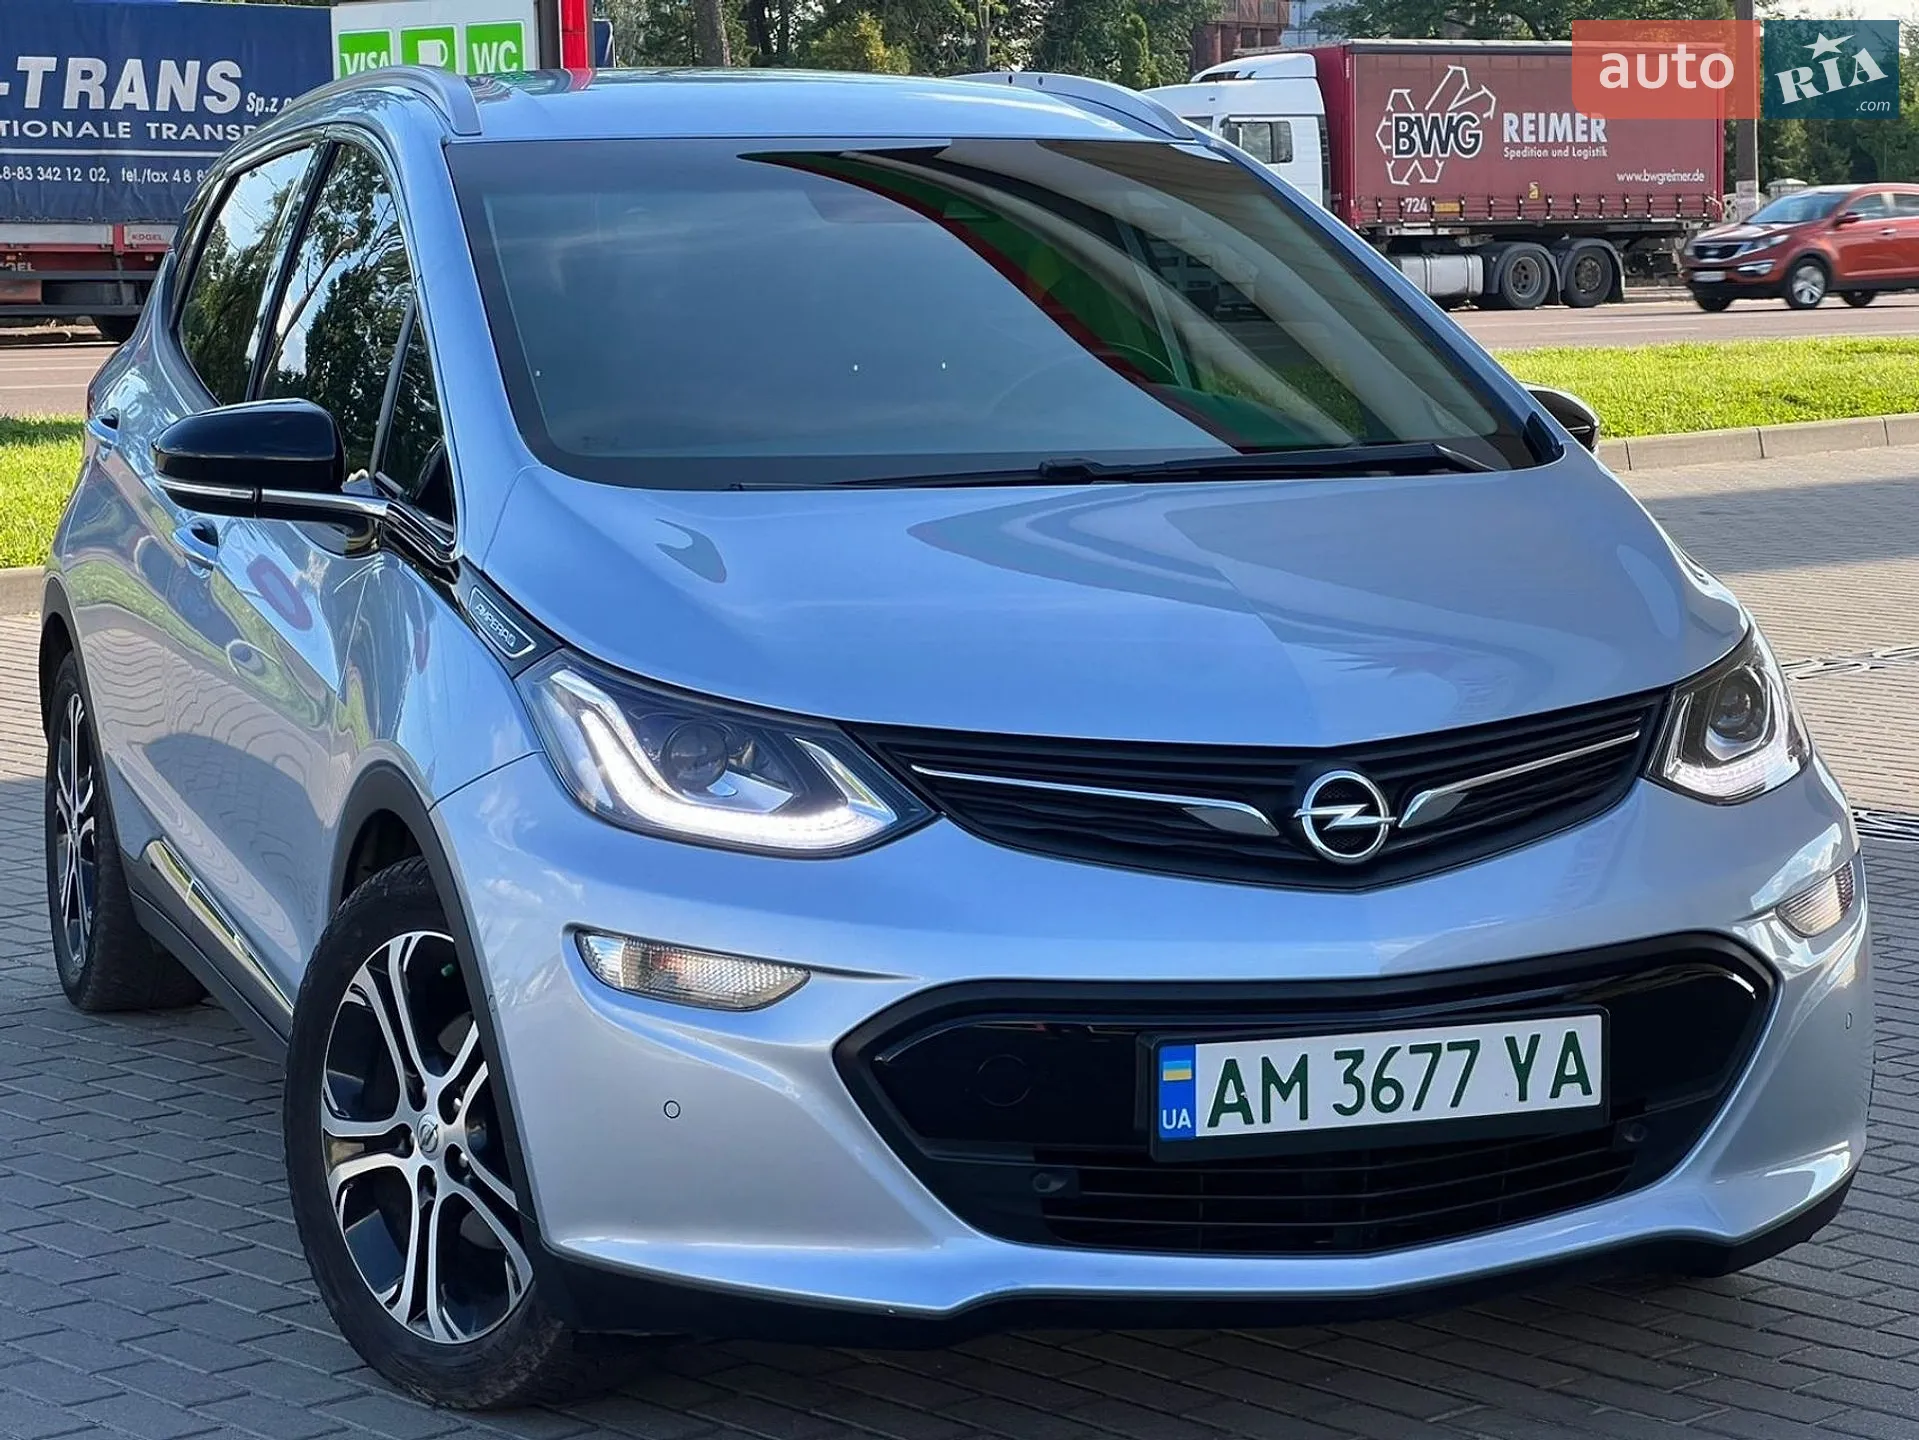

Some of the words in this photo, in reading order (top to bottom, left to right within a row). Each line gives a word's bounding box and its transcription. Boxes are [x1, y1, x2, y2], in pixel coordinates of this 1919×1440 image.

[340, 50, 390, 75] VISA
[472, 40, 518, 73] WC
[1393, 111, 1482, 158] BWG
[1503, 112, 1608, 143] REIMER
[1503, 146, 1549, 160] Spedition
[1552, 146, 1569, 157] und
[1572, 146, 1608, 160] Logistik
[0, 165, 33, 181] 8-83
[37, 166, 62, 182] 342
[66, 167, 82, 182] 12
[121, 167, 168, 184] tel./fax
[1616, 168, 1705, 185] www.bwgreimer.de
[1405, 198, 1427, 213] 724
[1207, 1053, 1308, 1128] AM
[1333, 1039, 1480, 1117] 3677
[1505, 1030, 1593, 1101] YA
[1162, 1109, 1191, 1130] UA
